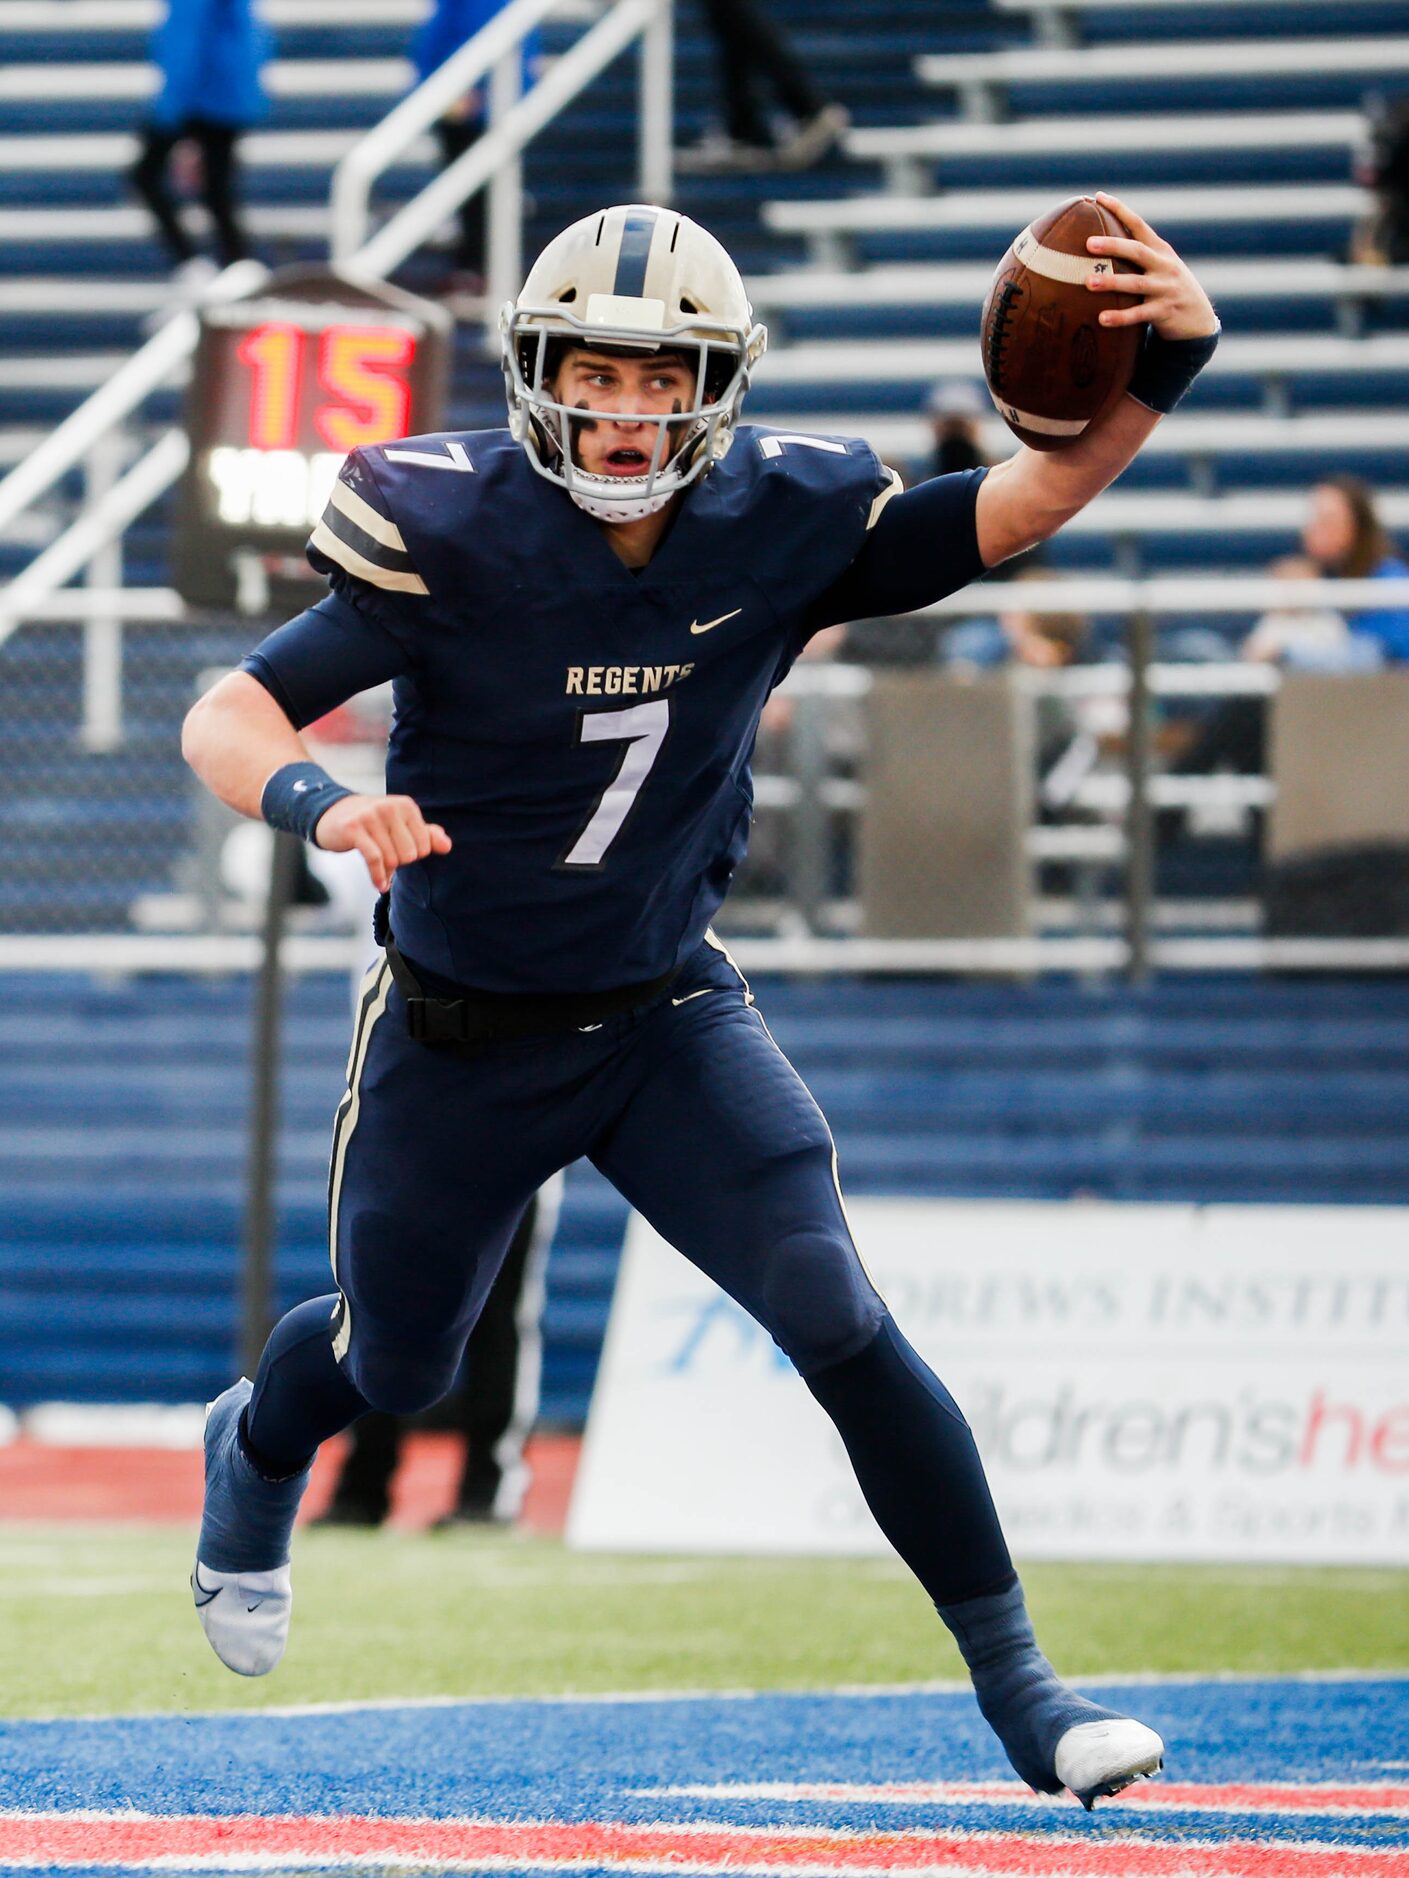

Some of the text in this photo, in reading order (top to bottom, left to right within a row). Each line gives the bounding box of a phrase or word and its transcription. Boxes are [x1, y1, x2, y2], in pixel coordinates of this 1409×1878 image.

[237, 320, 416, 453] 15
[565, 662, 695, 695] REGENTS
[558, 698, 670, 864] 7
[1145, 1270, 1409, 1326] INSTIT
